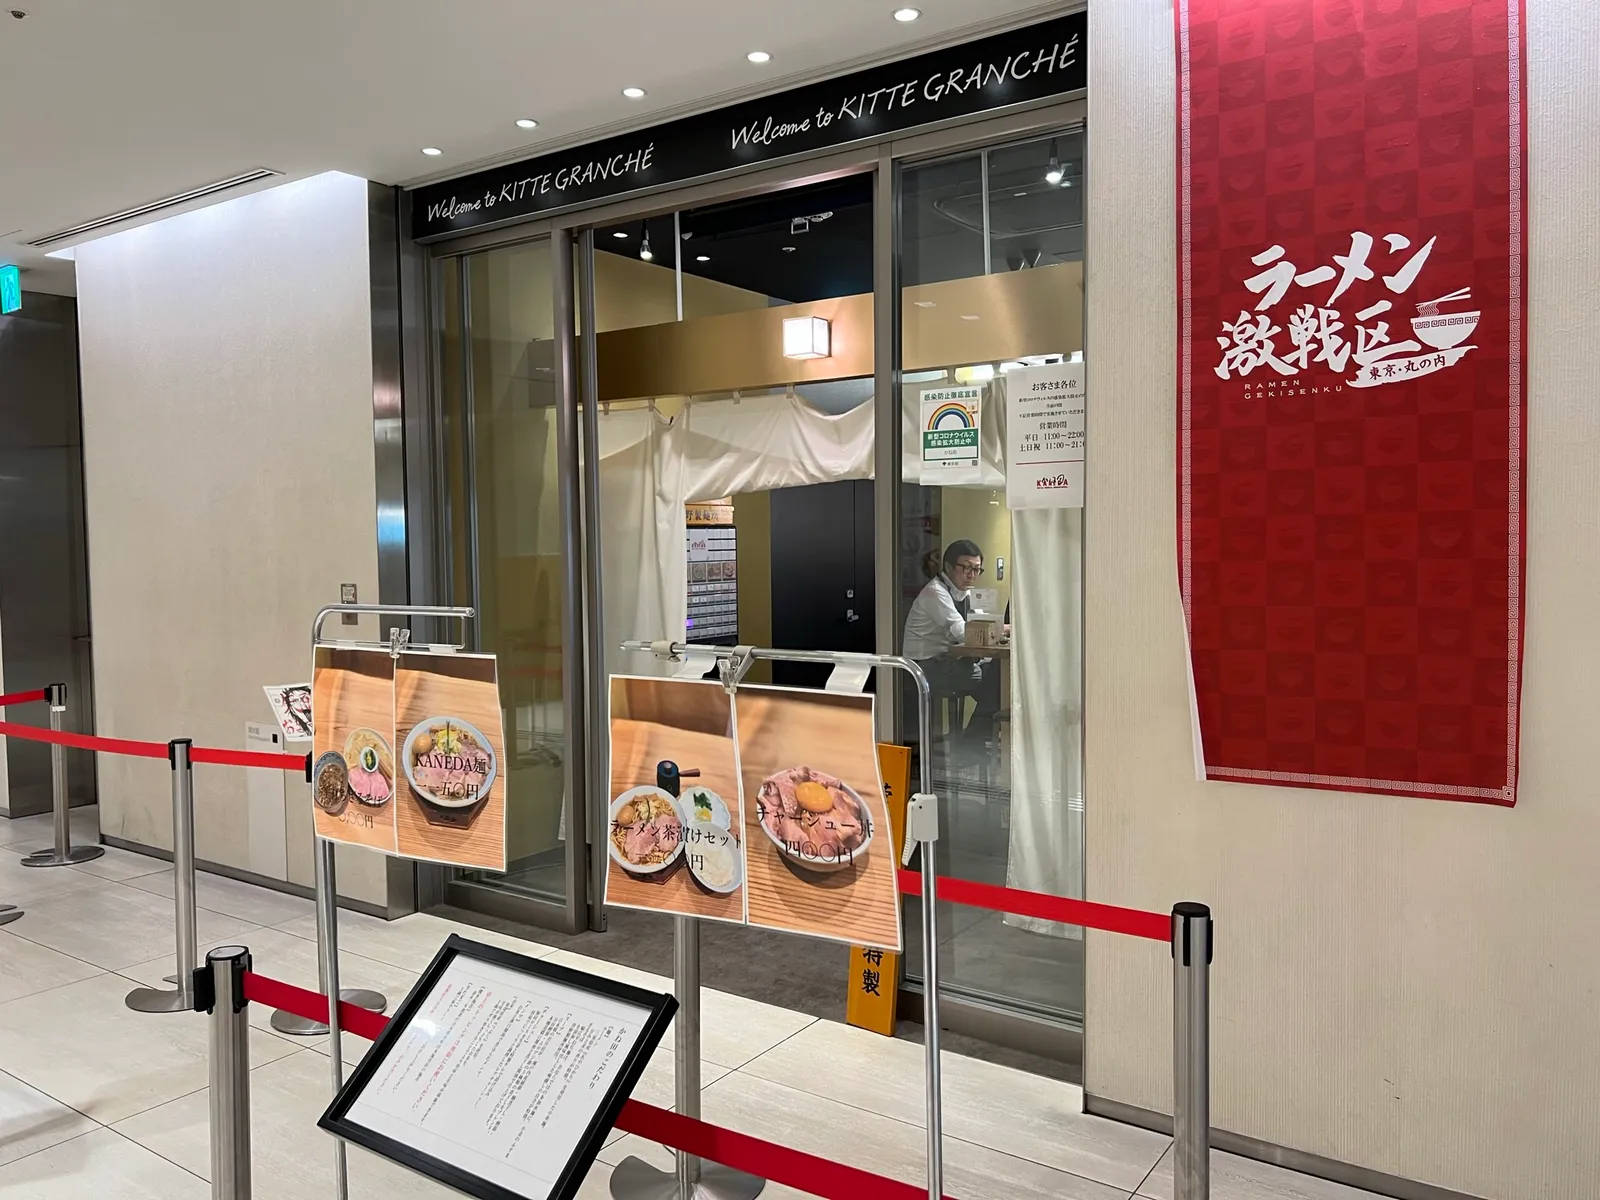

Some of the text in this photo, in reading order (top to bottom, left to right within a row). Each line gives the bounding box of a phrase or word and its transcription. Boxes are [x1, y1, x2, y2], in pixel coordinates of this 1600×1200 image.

[731, 33, 1079, 150] Welcome to KITTE GRANCHÉ
[427, 143, 656, 222] Welcome to KITTE GRANCHÉ
[1243, 231, 1437, 311] ラーメン
[1213, 300, 1422, 380] 激戦区
[1369, 354, 1447, 380] 東京・丸の内
[1031, 379, 1077, 391] お客さま各位
[1244, 379, 1301, 391] RAMEN
[1244, 385, 1343, 399] GEKISENKU
[1025, 433, 1039, 442] 平日
[1039, 420, 1068, 430] 営業時間
[586, 1026, 628, 1090] かね田のこだわり
